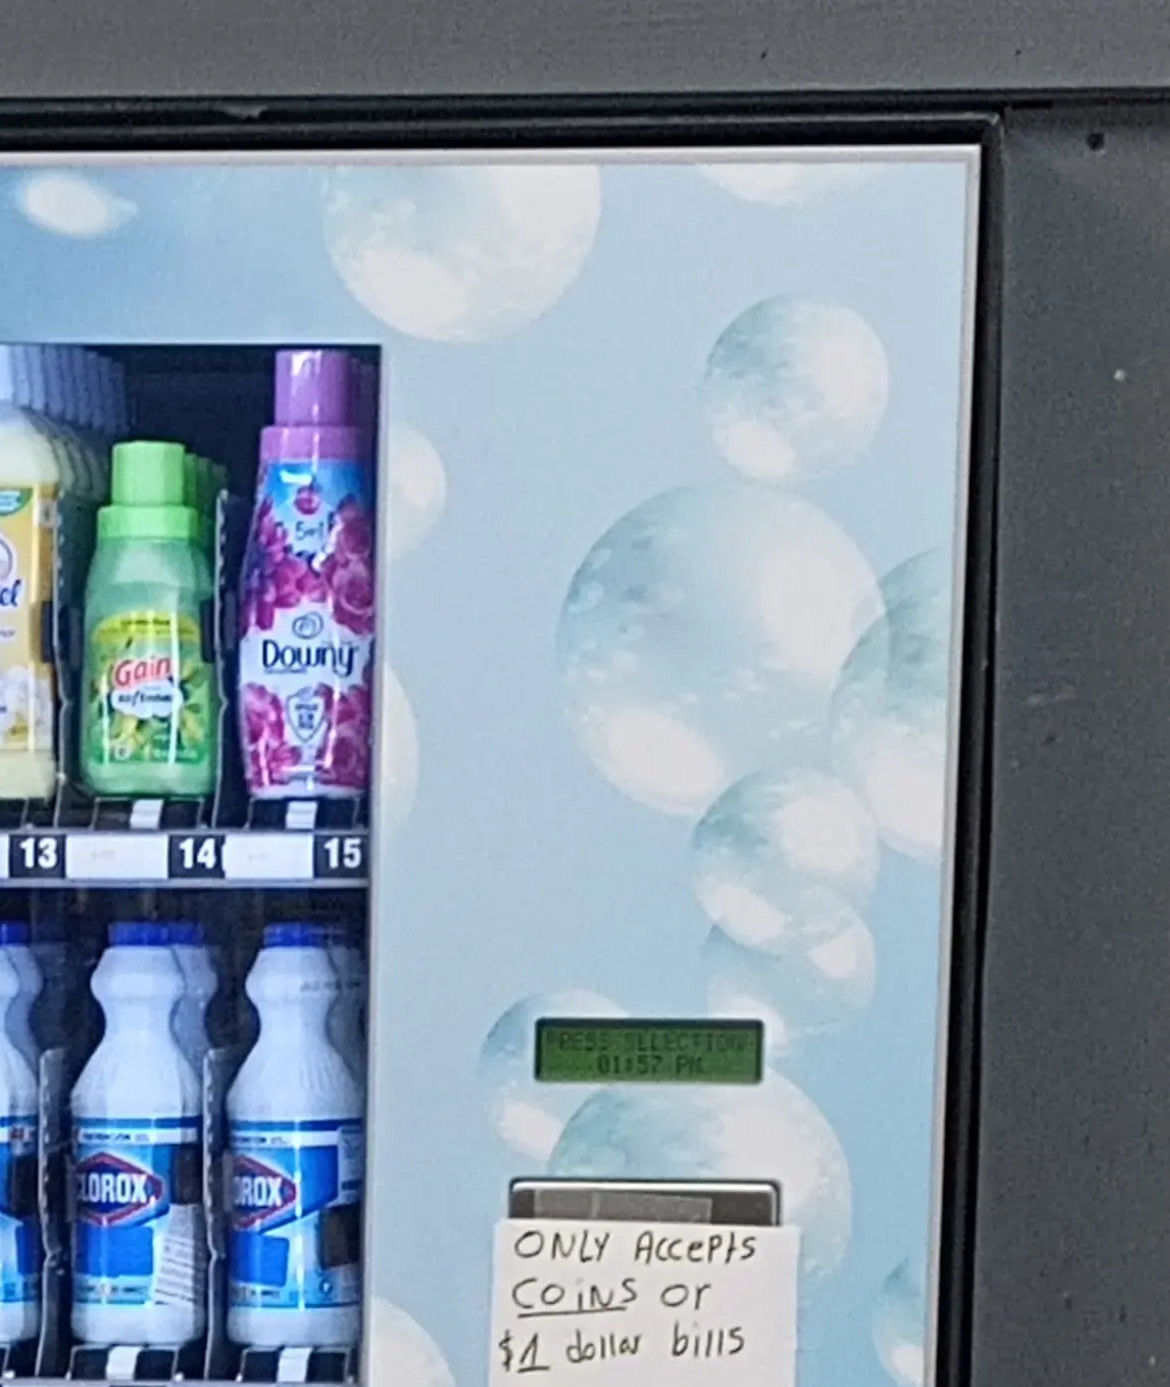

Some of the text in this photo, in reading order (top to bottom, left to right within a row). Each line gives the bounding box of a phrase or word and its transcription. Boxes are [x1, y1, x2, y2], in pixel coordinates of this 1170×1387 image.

[114, 656, 172, 686] Gain
[262, 638, 355, 677] Downy
[21, 838, 57, 867] 13
[180, 839, 217, 867] 14
[325, 839, 362, 866] 15
[597, 1055, 664, 1076] 01:57
[514, 1230, 610, 1263] ONLY
[498, 1320, 746, 1373] $1 dollar bills
